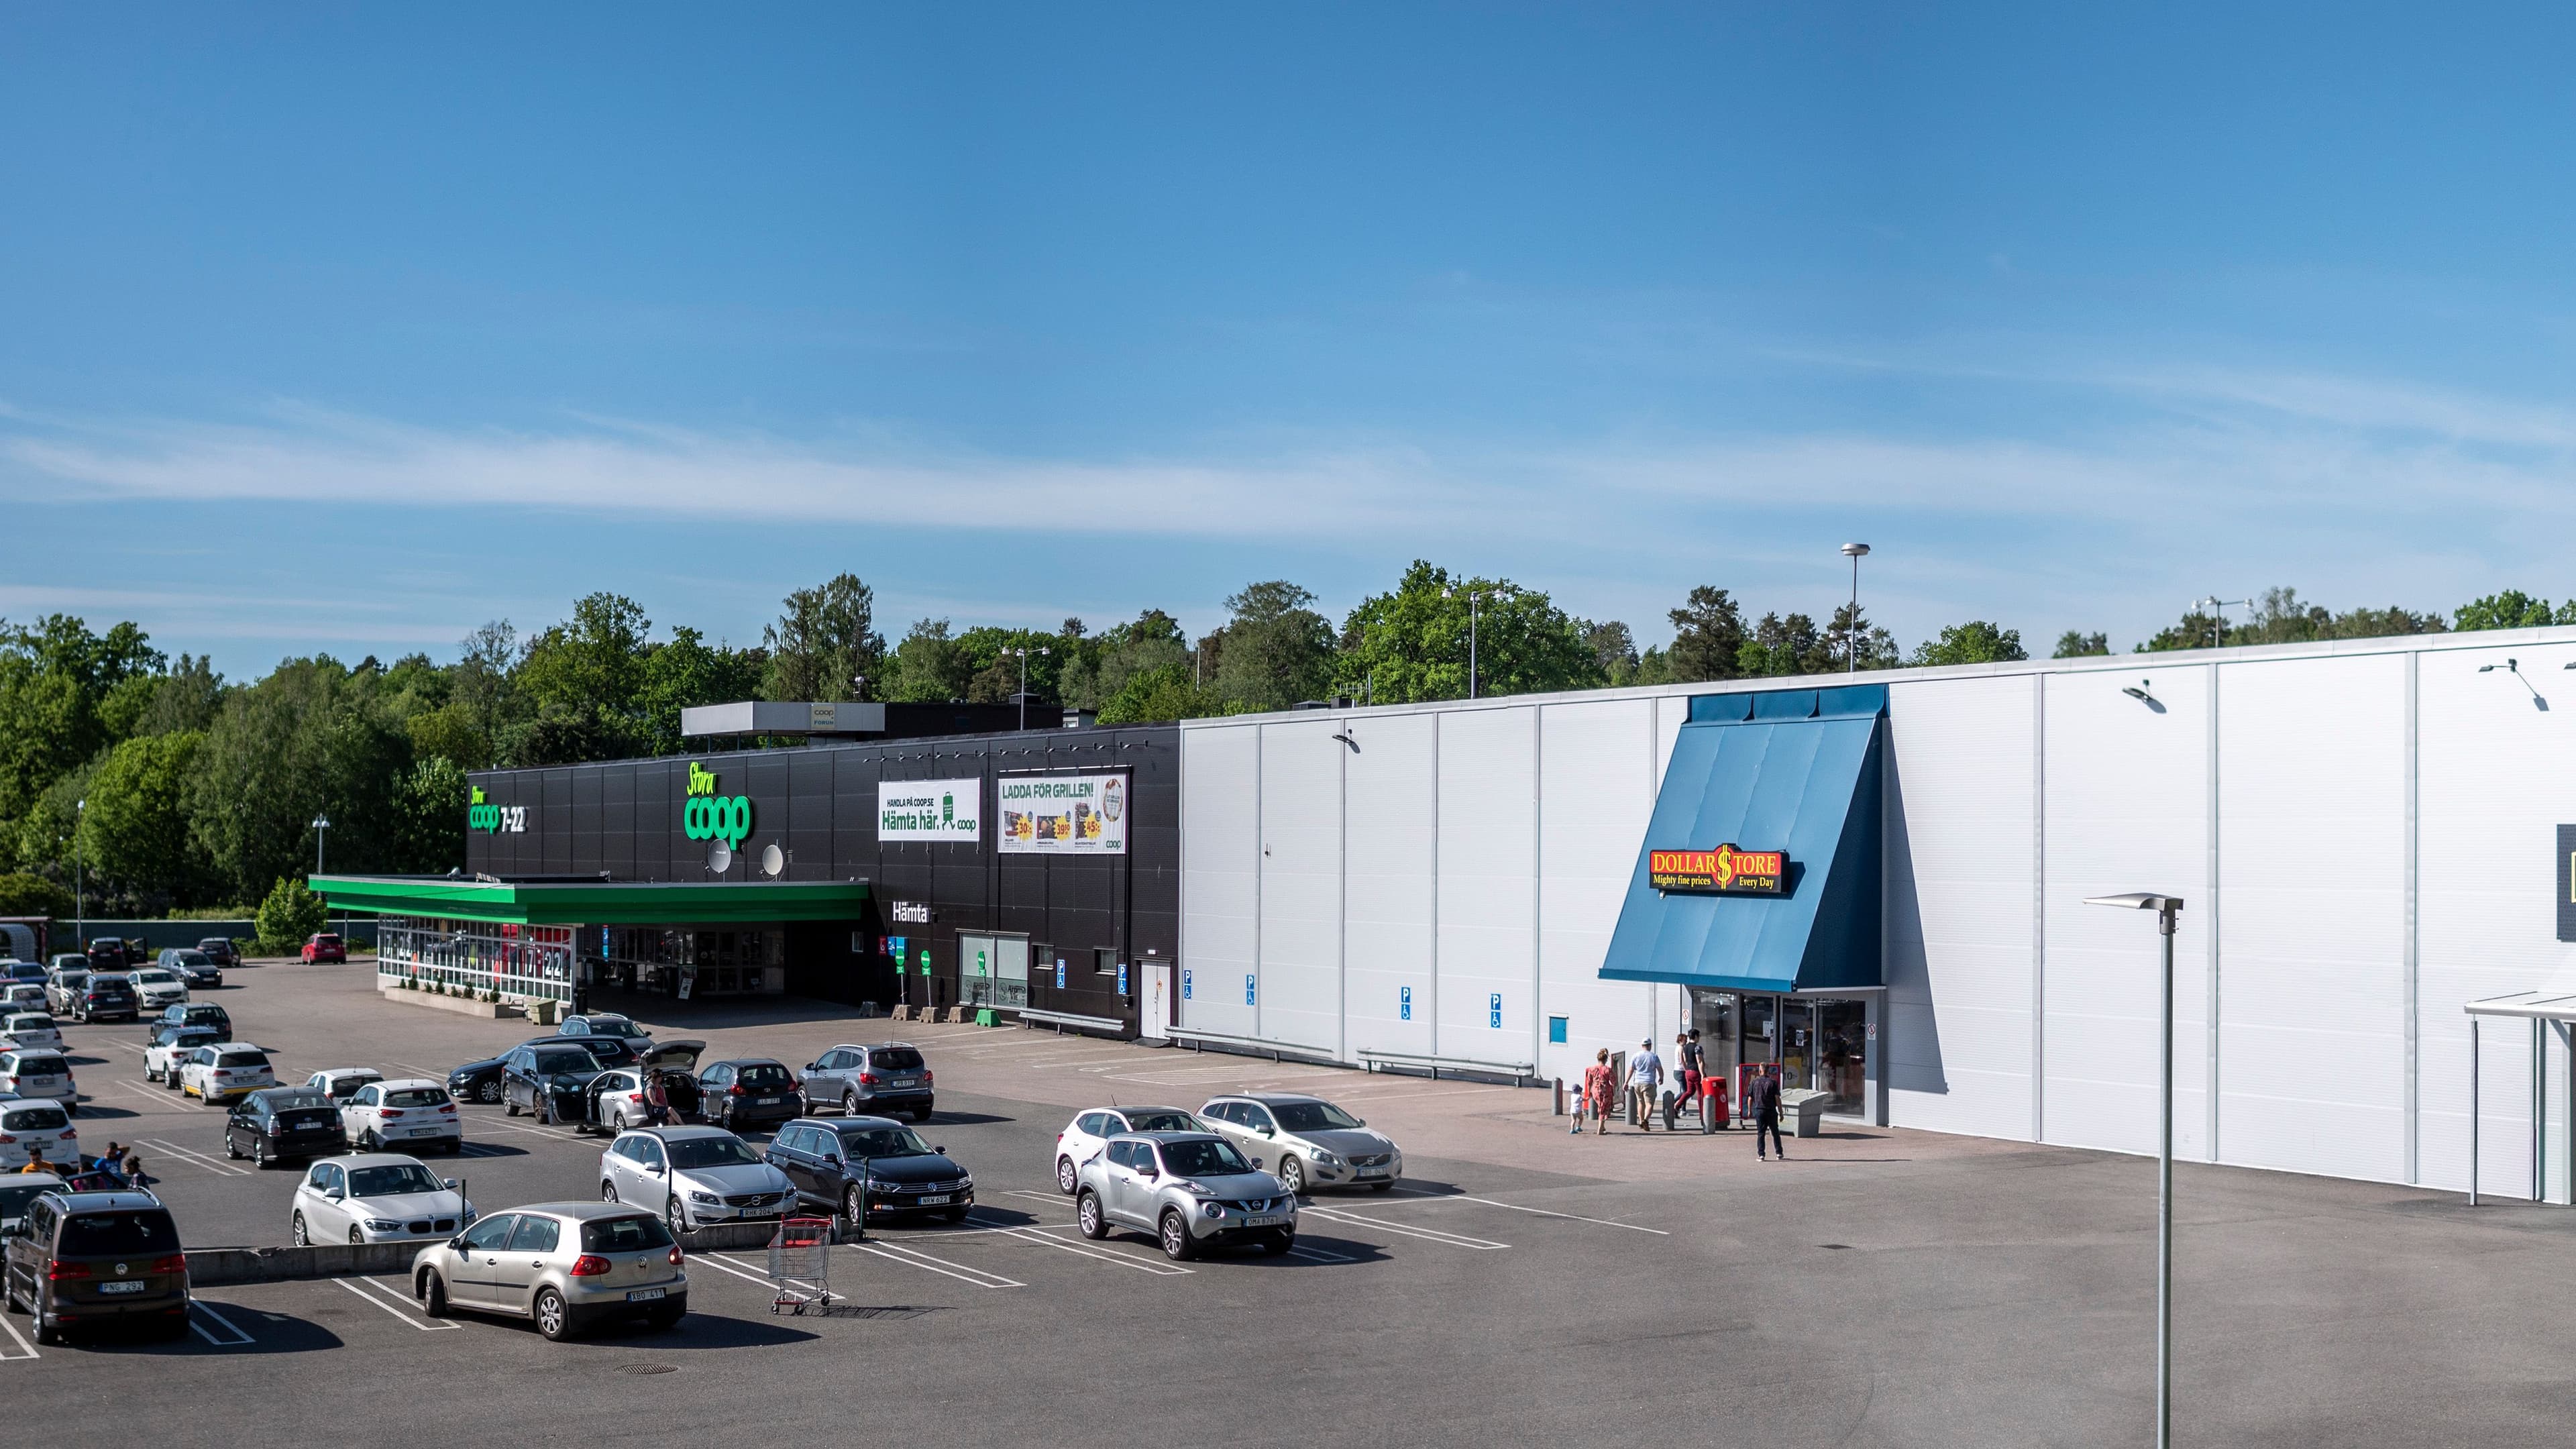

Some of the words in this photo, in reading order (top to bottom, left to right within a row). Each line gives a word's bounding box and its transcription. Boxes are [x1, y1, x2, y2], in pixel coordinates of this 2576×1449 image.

[687, 761, 714, 796] Stora
[1002, 784, 1032, 799] LADDA
[1033, 782, 1052, 798] FÖR
[1053, 782, 1093, 798] GRILLEN!
[887, 798, 906, 807] HANDLA
[906, 796, 914, 807] PÅ
[914, 798, 934, 807] COOP.SE
[470, 805, 498, 835] coop
[500, 806, 525, 832] 7-22
[684, 796, 750, 851] coop
[882, 810, 917, 830] Hämta
[919, 809, 939, 830] här.
[957, 819, 976, 833] coop
[1106, 840, 1121, 850] coop
[1653, 875, 1676, 886] Mighty
[1678, 875, 1690, 885] fine
[1691, 877, 1711, 888] prices
[1739, 877, 1758, 889] Every
[1759, 878, 1774, 890] Day
[893, 901, 928, 923] Hämta
[1059, 961, 1063, 973] P
[1120, 966, 1125, 977] P
[1185, 971, 1190, 983] P
[1248, 976, 1253, 988] P
[1403, 987, 1409, 1002] P
[1493, 995, 1499, 1009] P
[125, 1282, 142, 1290] 292
[650, 1289, 663, 1298] 411
